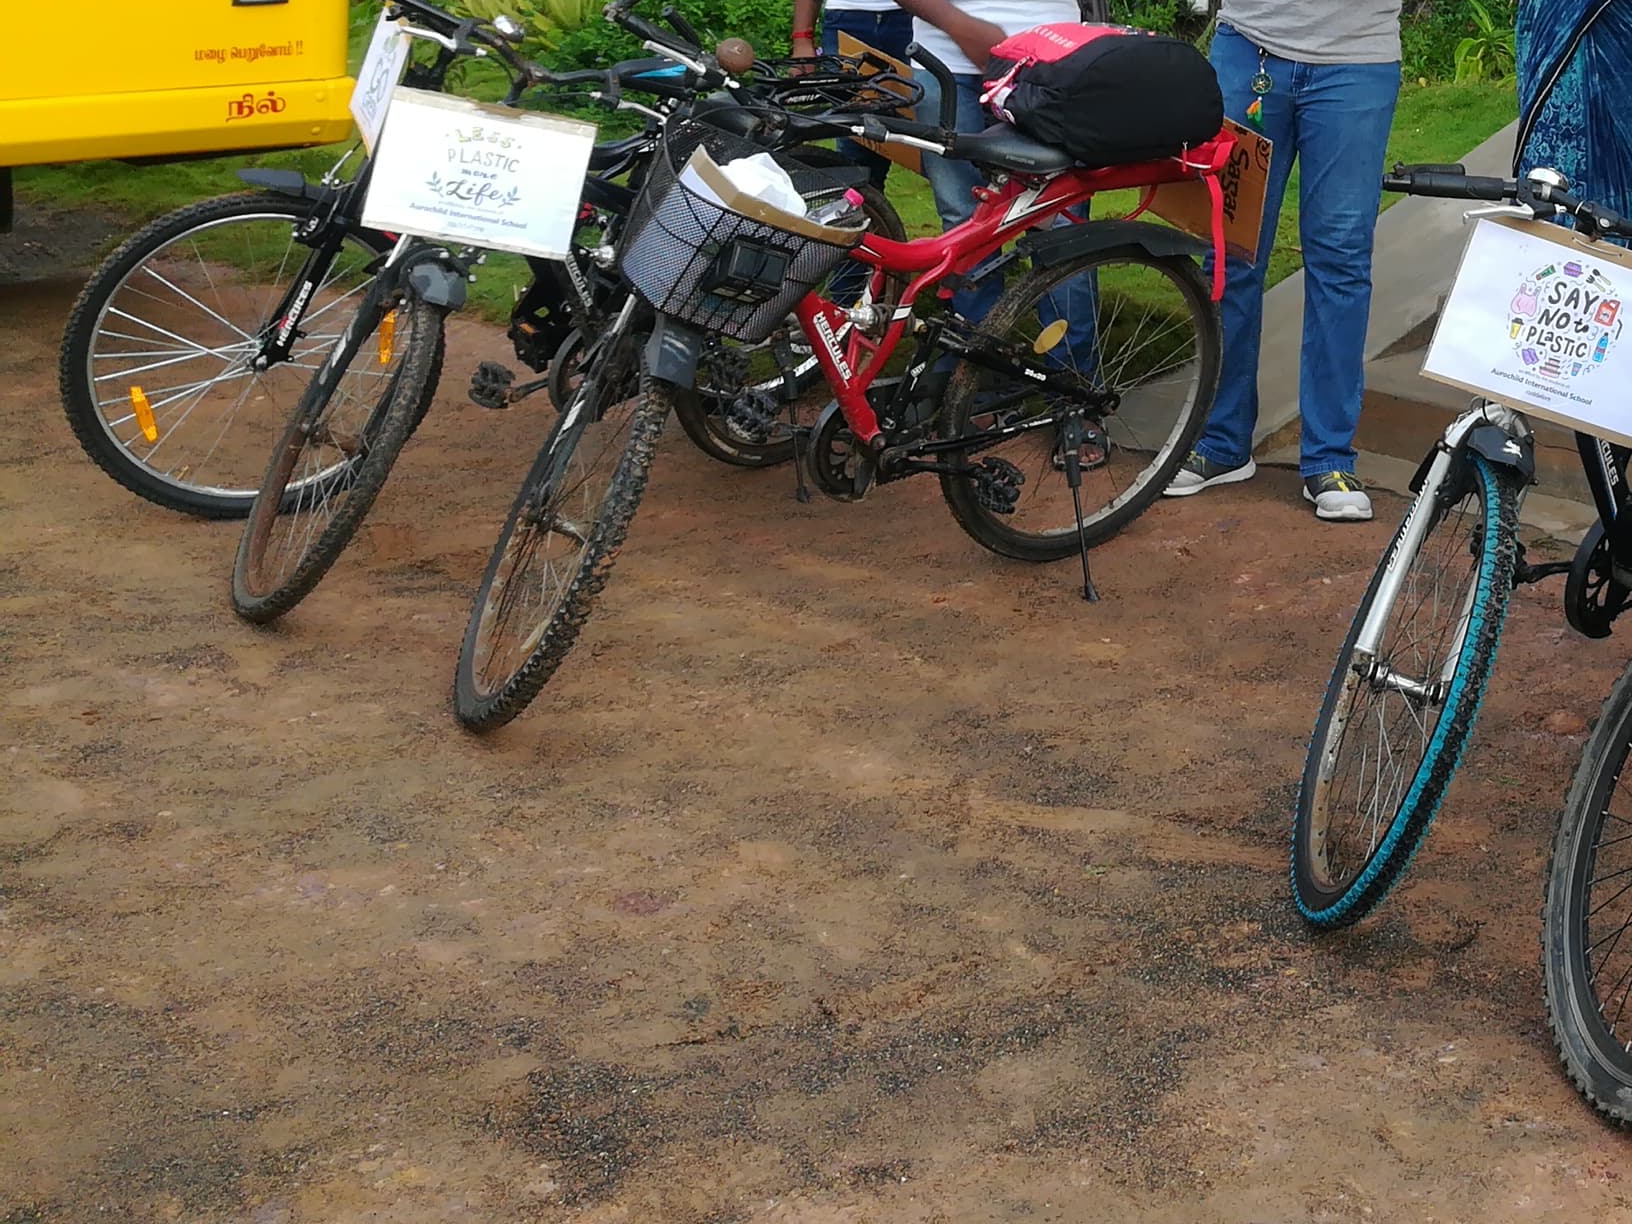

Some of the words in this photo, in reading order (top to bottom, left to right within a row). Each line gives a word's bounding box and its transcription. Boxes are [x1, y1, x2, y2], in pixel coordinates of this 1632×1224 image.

[225, 90, 286, 122] நில்
[448, 148, 520, 173] PLASTIC
[461, 168, 498, 180] more
[446, 179, 504, 206] Life
[276, 280, 313, 347] HERCULES
[1548, 281, 1600, 315] SAY
[1537, 308, 1571, 330] NO
[1574, 318, 1590, 333] to
[813, 311, 852, 381] HERCULES
[1491, 368, 1525, 383] Aurochild
[1525, 378, 1569, 398] International
[1569, 393, 1593, 406] School
